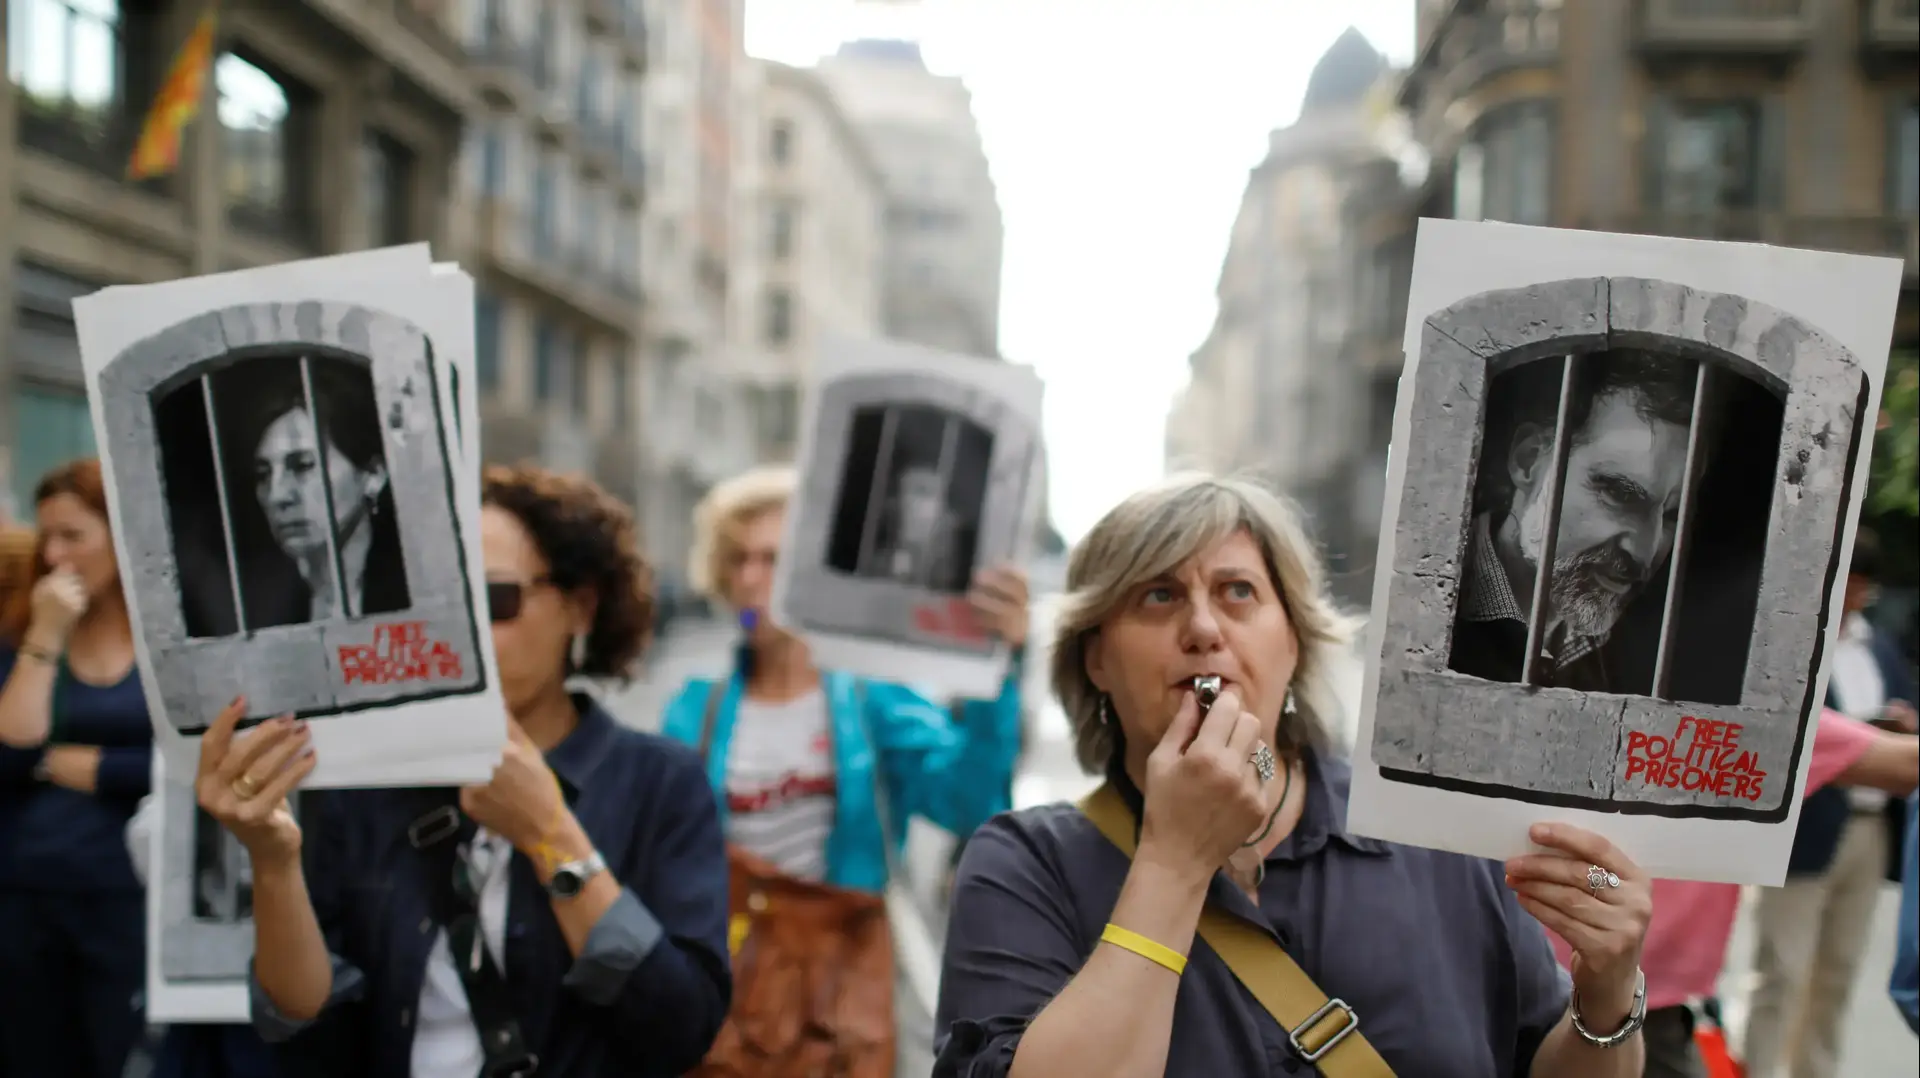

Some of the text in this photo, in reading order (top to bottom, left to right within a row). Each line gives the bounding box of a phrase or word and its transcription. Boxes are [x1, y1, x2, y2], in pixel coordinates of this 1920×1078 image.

[1627, 731, 1767, 777] POLITICAL
[1675, 716, 1745, 748] FREE
[1625, 756, 1764, 802] PRISONERS
